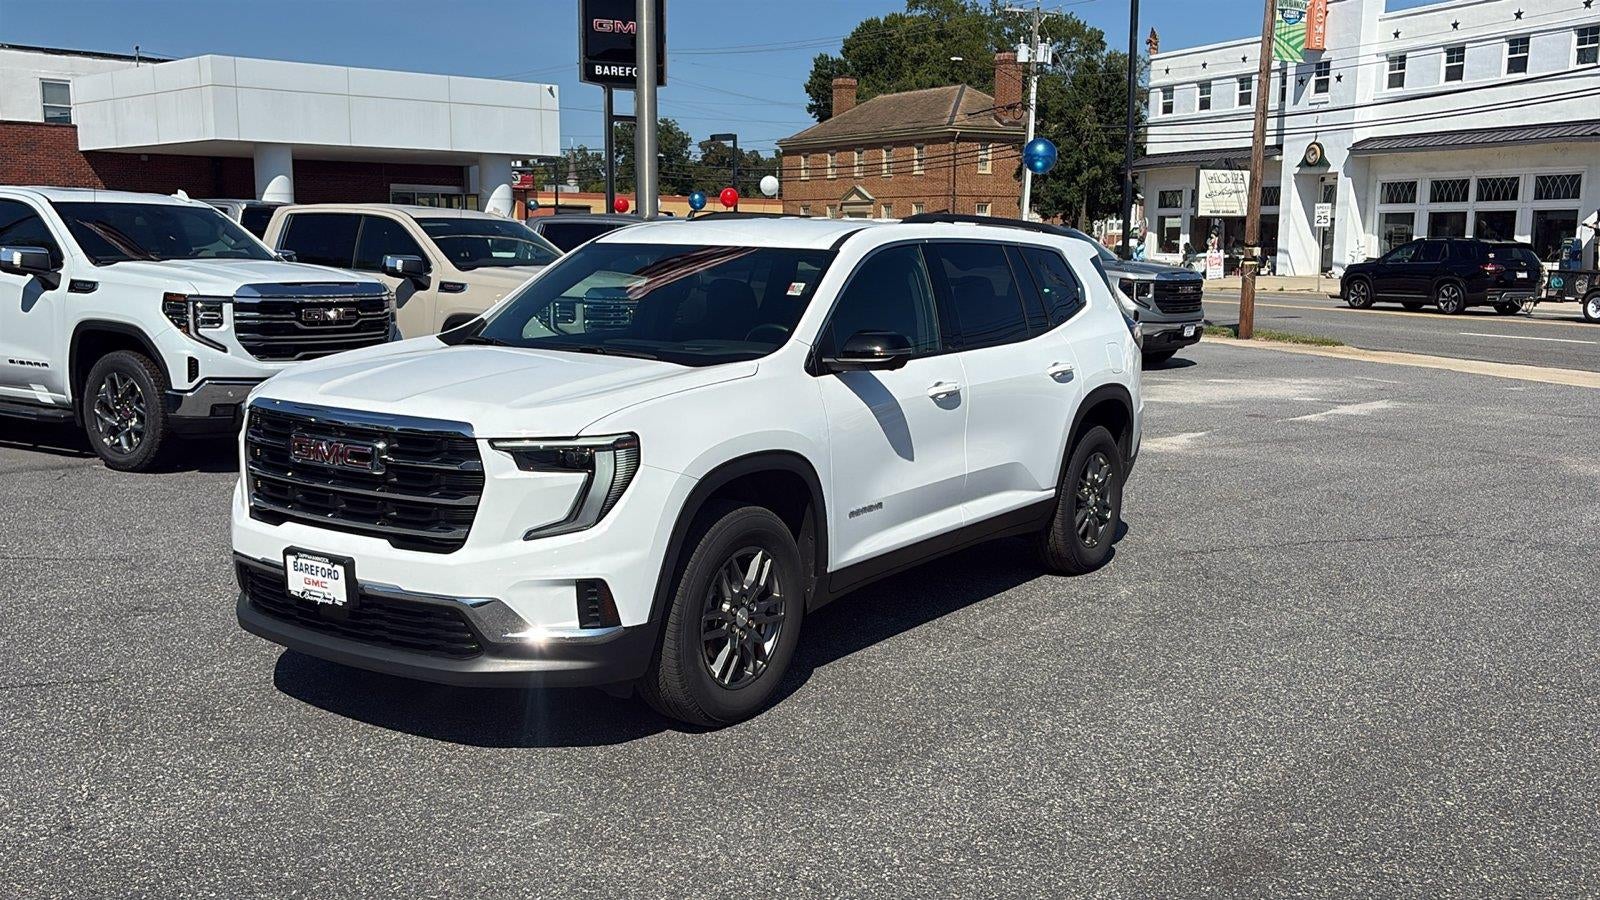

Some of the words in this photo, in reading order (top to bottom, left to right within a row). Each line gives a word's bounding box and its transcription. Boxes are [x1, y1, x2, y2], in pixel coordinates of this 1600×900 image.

[593, 18, 637, 34] GM
[595, 65, 637, 77] BAREFO
[1316, 215, 1329, 224] 25
[302, 307, 356, 321] GMC
[290, 433, 372, 469] GMC
[293, 561, 340, 581] BAREFORD
[303, 577, 328, 589] GMC
